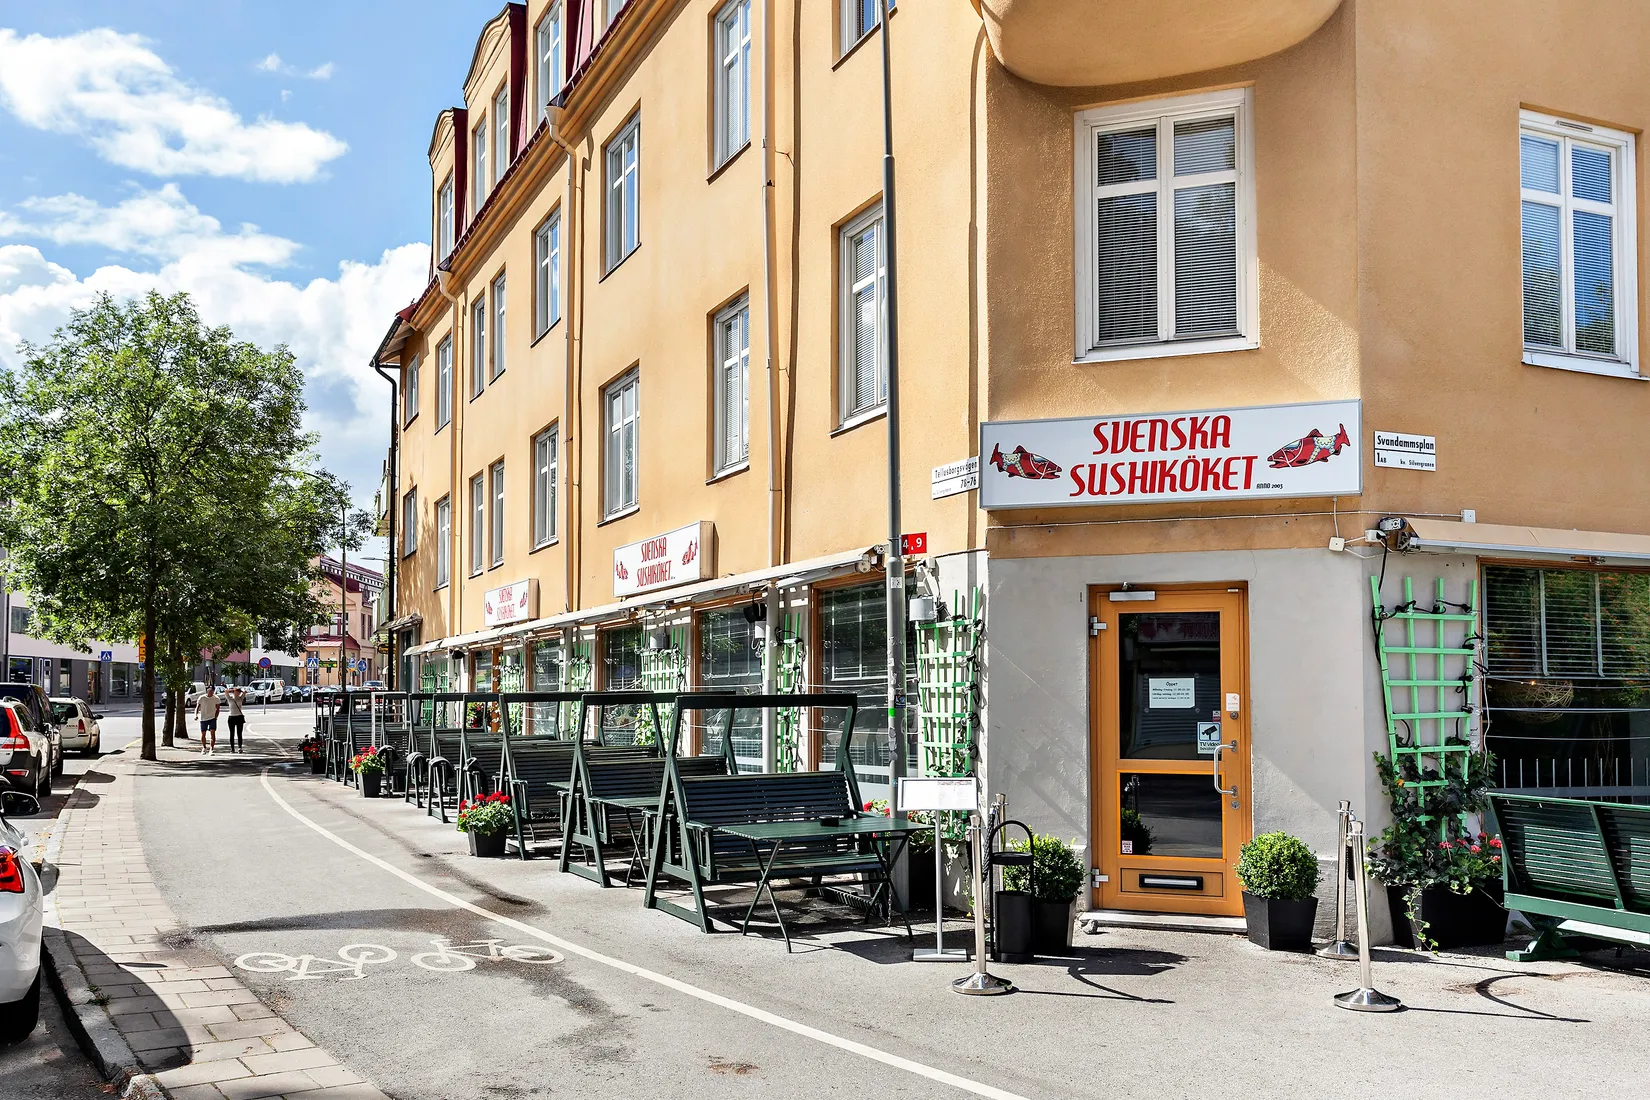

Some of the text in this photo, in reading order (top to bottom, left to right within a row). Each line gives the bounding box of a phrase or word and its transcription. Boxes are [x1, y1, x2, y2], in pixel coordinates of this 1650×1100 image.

[1092, 414, 1231, 456] SVENSKA
[1377, 435, 1434, 451] Svandammsplan
[1069, 454, 1258, 497] SUSHIKÖKET
[641, 537, 667, 563] SVENSKA
[637, 560, 672, 588] SUSHIKÖKET
